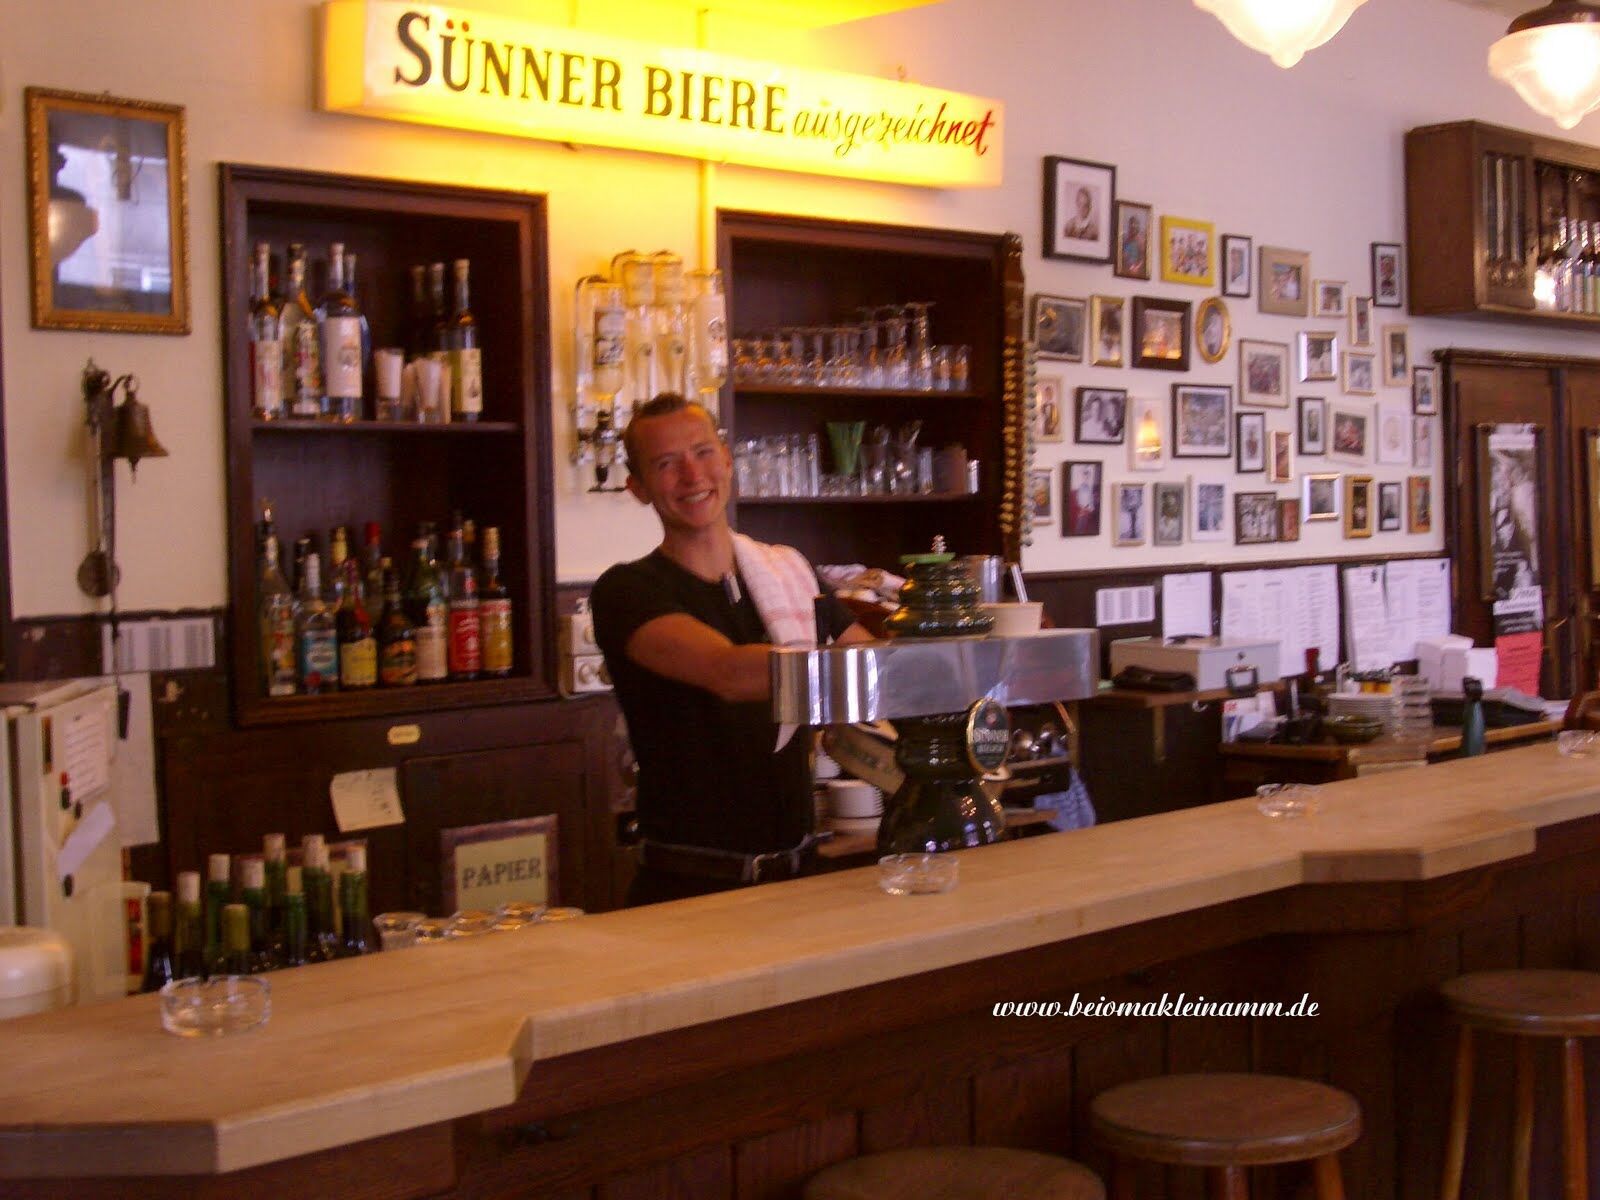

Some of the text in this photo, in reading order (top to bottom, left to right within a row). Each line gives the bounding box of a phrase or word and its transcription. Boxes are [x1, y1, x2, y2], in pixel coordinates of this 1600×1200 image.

[395, 13, 994, 157] SÜNNER BIERE ausgezeichnet
[462, 858, 541, 889] PAPIER
